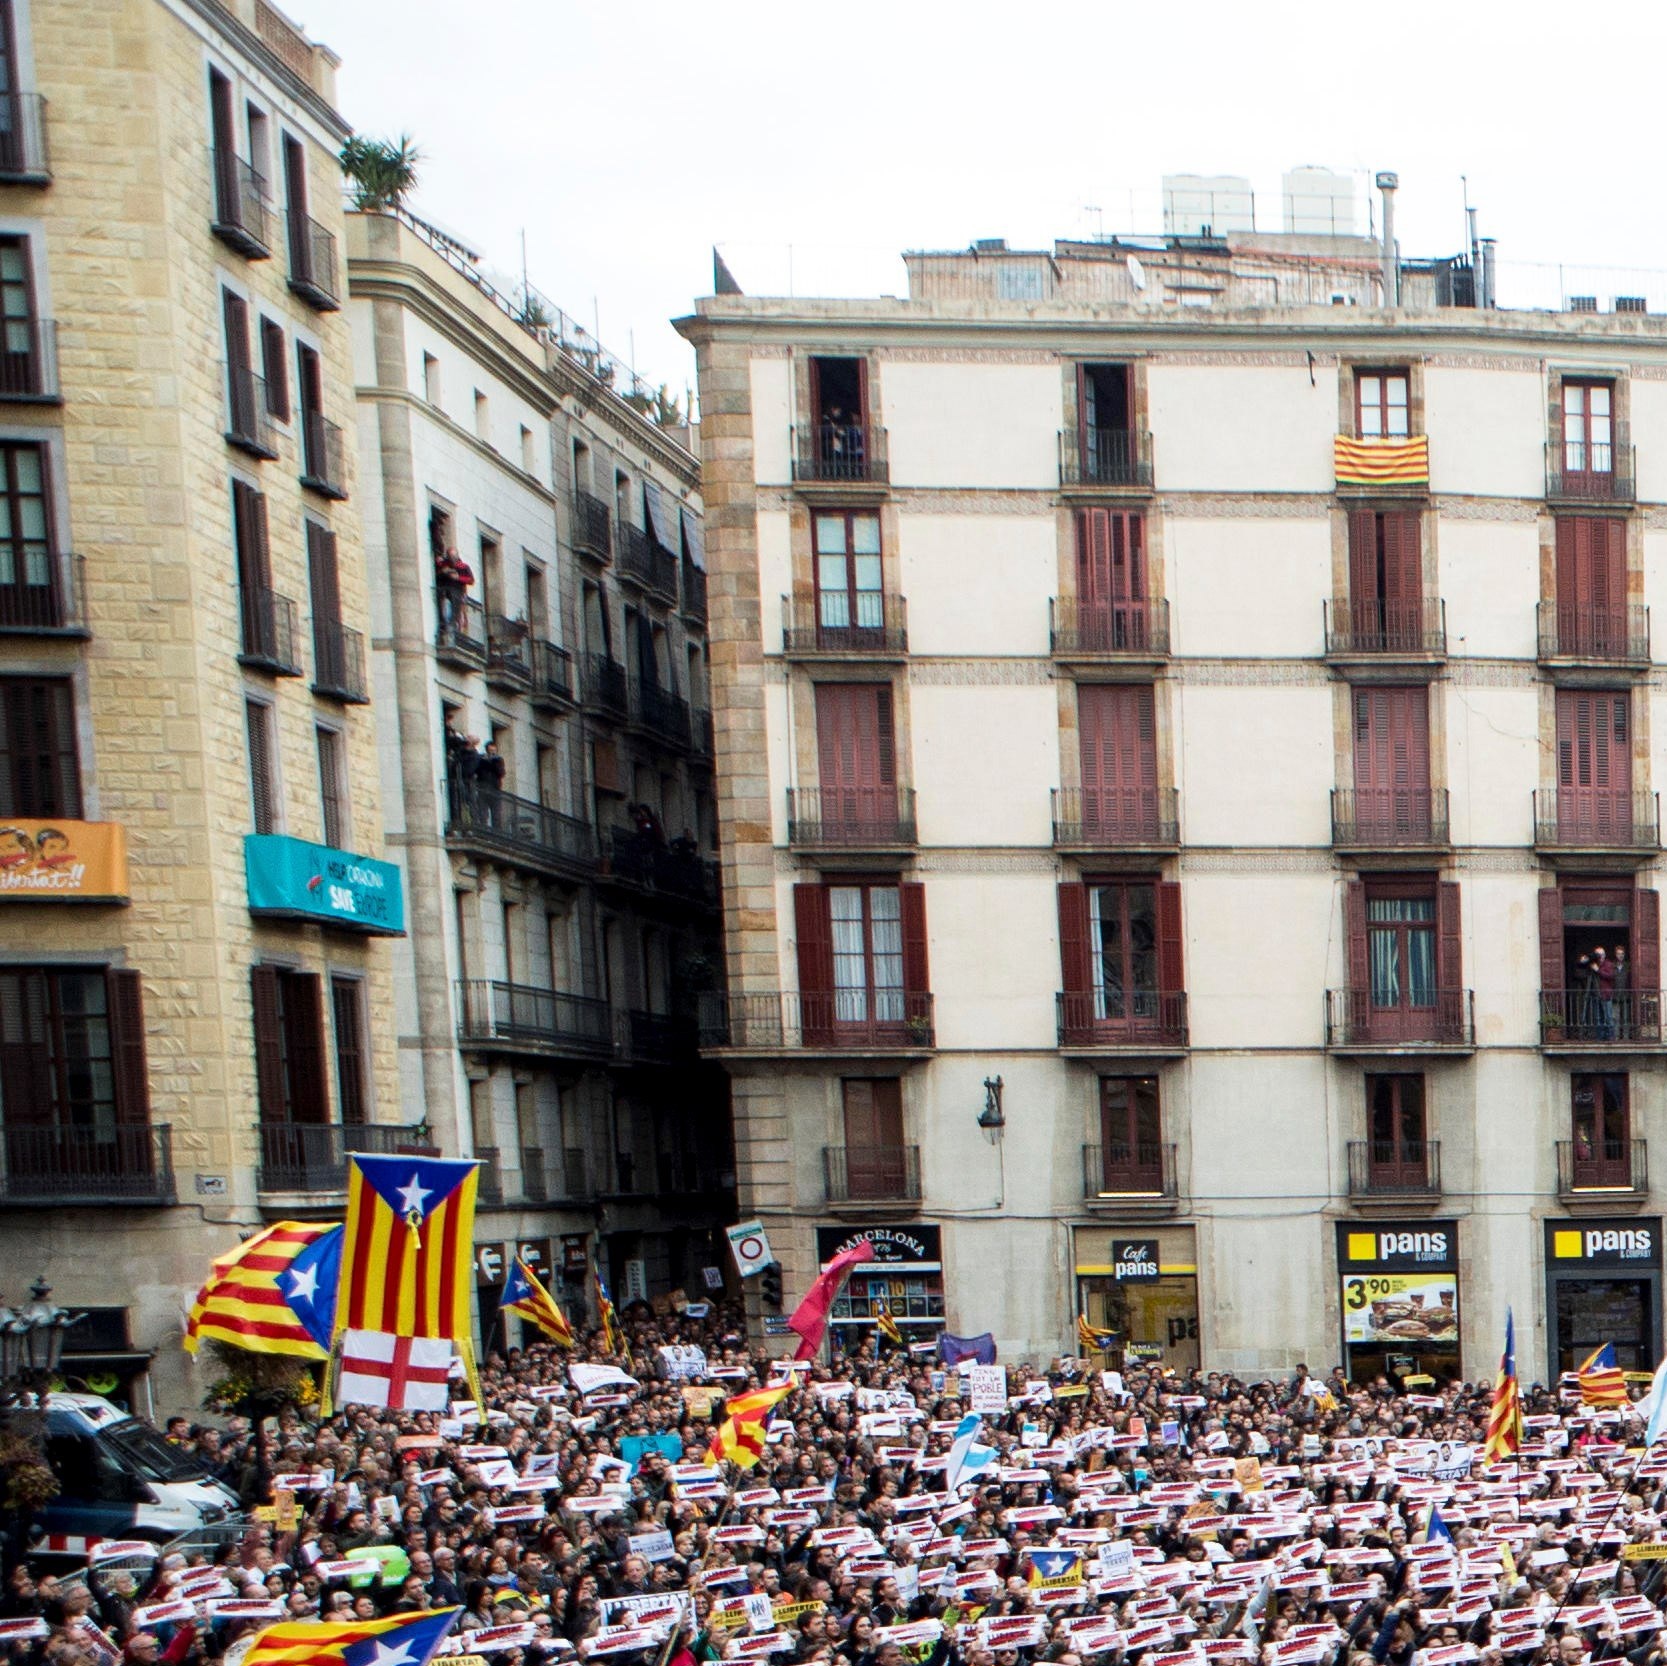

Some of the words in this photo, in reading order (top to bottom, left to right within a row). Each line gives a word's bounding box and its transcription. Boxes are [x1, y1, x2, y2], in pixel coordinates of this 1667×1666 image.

[329, 885, 356, 912] SAVE
[835, 1229, 925, 1257] BARCELONA
[1380, 1232, 1447, 1260] pans
[1586, 1230, 1651, 1258] pans
[1626, 1249, 1651, 1258] COMPANY
[1116, 1262, 1158, 1279] pans
[1421, 1253, 1447, 1261] COMPANY
